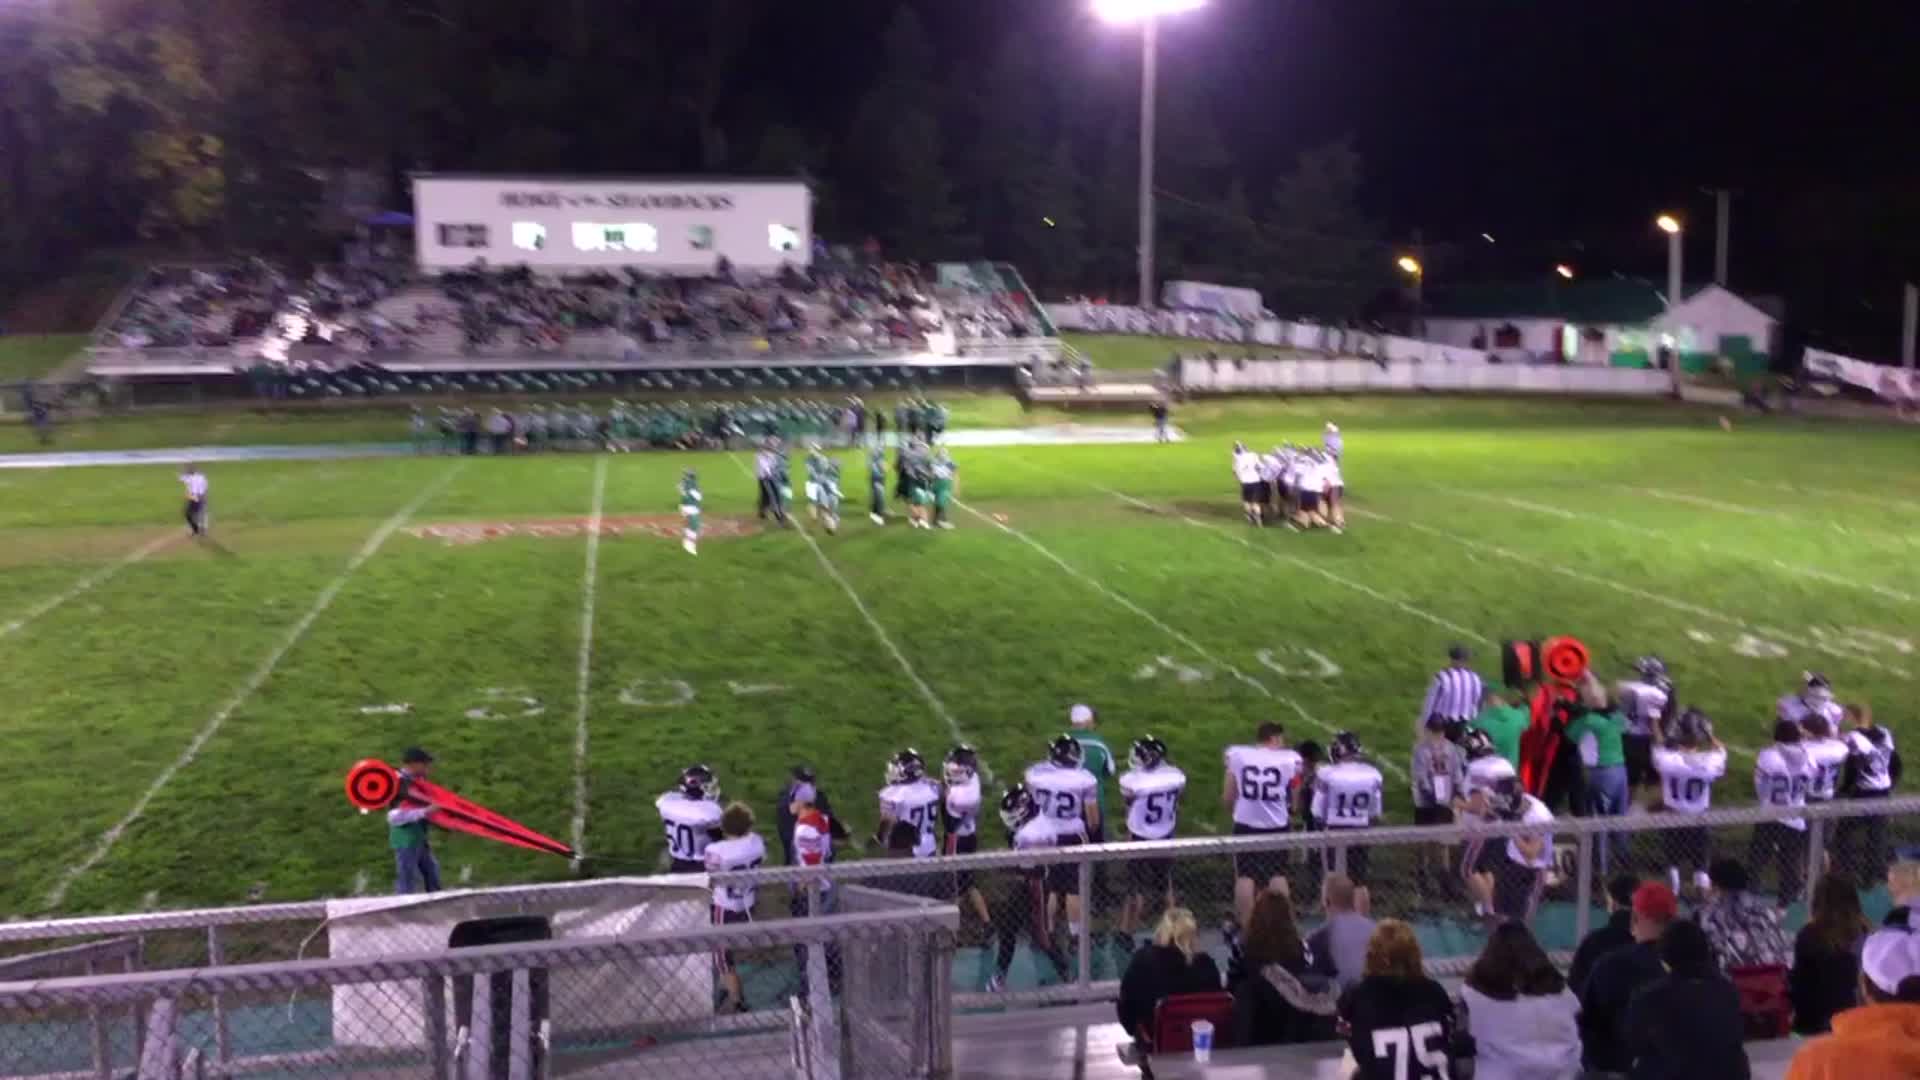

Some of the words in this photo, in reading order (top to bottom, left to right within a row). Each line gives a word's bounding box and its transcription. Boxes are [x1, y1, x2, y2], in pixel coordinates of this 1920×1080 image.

[1240, 765, 1282, 802] 62
[1668, 776, 1705, 803] 10
[1035, 787, 1079, 820] 72
[1144, 788, 1179, 825] 57
[664, 818, 695, 858] 50
[1370, 1020, 1450, 1080] 75
